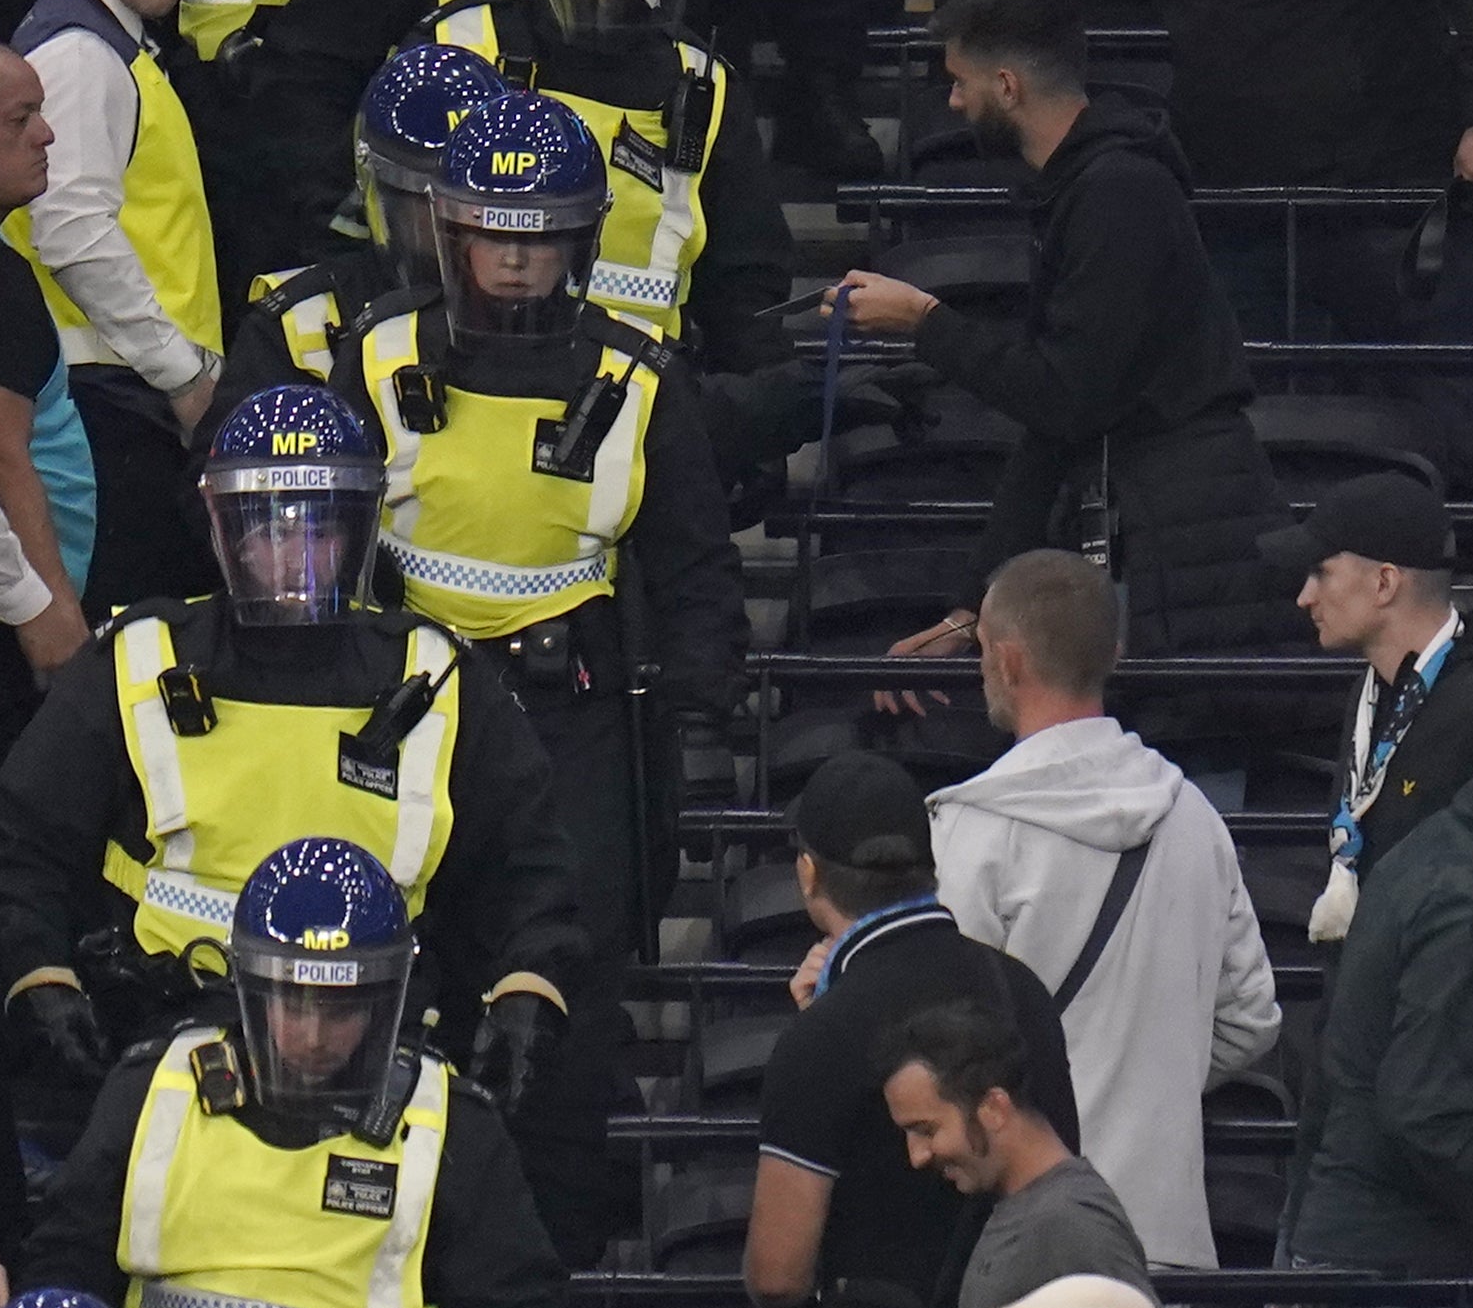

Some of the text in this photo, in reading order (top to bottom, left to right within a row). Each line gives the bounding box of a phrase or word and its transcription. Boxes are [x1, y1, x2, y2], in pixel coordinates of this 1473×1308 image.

[490, 151, 538, 176] MP
[485, 211, 541, 230] POLICE
[271, 431, 318, 456] MP
[270, 470, 328, 488] POLICE
[302, 929, 350, 951] MP
[297, 964, 354, 983] POLICE
